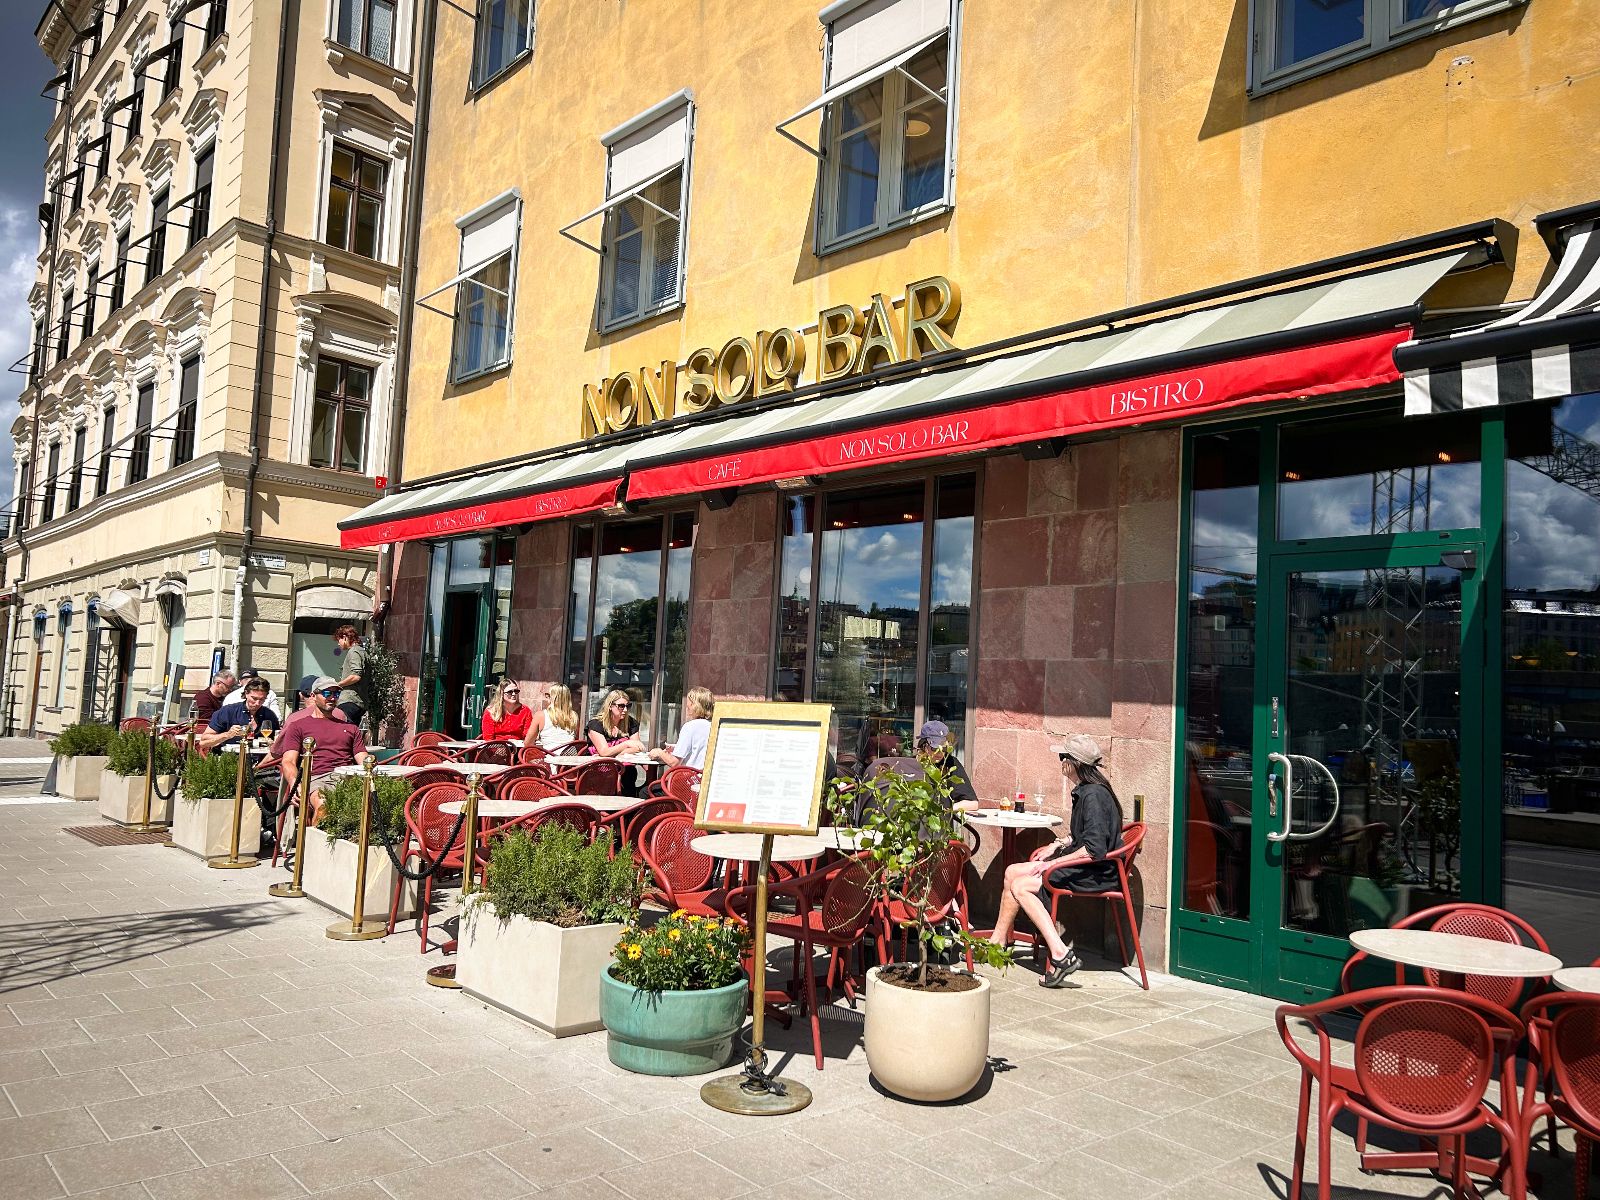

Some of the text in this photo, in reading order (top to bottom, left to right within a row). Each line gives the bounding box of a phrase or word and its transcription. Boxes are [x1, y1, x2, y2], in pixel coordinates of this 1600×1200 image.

[581, 276, 962, 440] NON SOLO BAR
[1110, 378, 1204, 415] BISTRO
[839, 420, 969, 460] NON SOLO BAR
